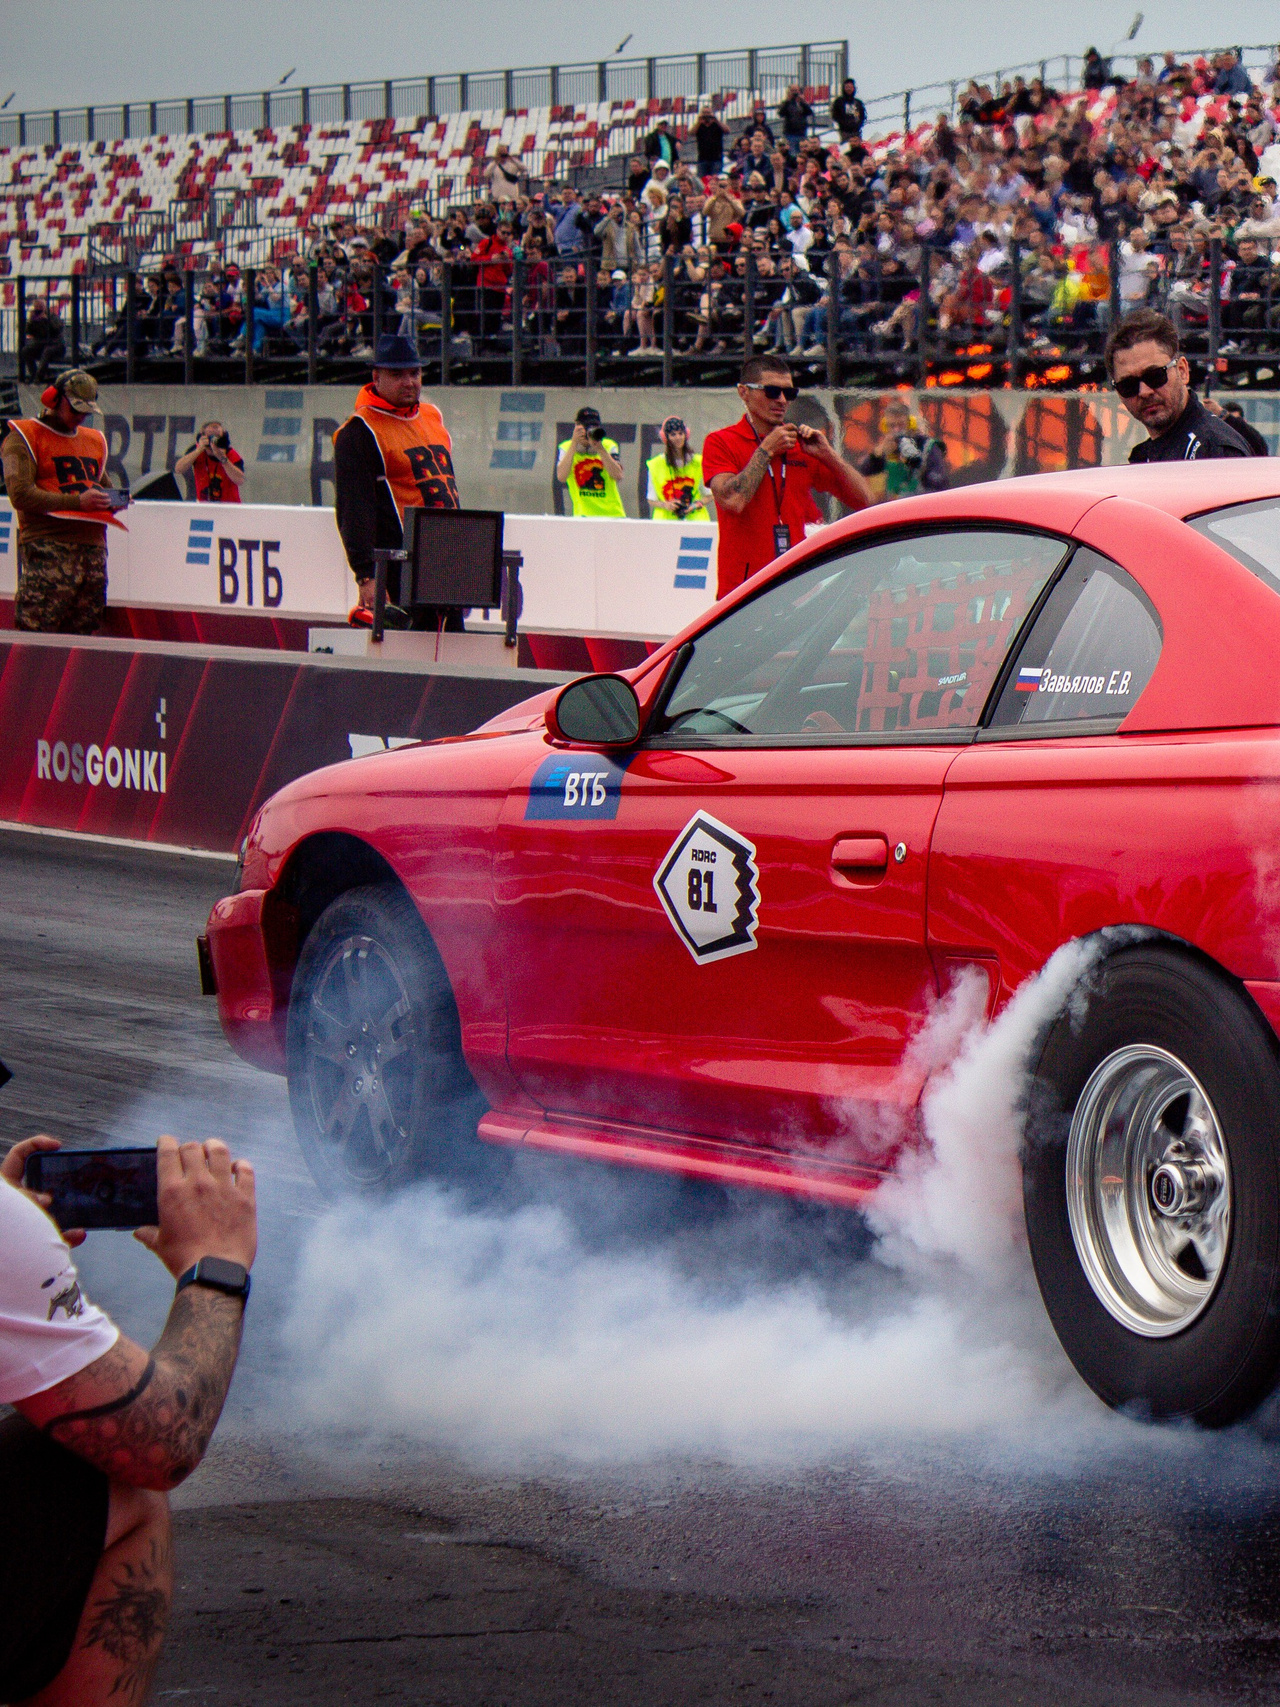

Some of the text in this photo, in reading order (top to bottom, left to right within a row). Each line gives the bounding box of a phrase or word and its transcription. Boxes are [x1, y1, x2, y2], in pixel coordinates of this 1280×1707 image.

[218, 537, 283, 608] ВТБ
[1038, 668, 1132, 695] Завьялов Е.В.
[37, 739, 167, 793] ROSGONKI
[563, 772, 609, 807] ВТБ
[691, 848, 717, 864] RDRC
[687, 868, 718, 914] 81
